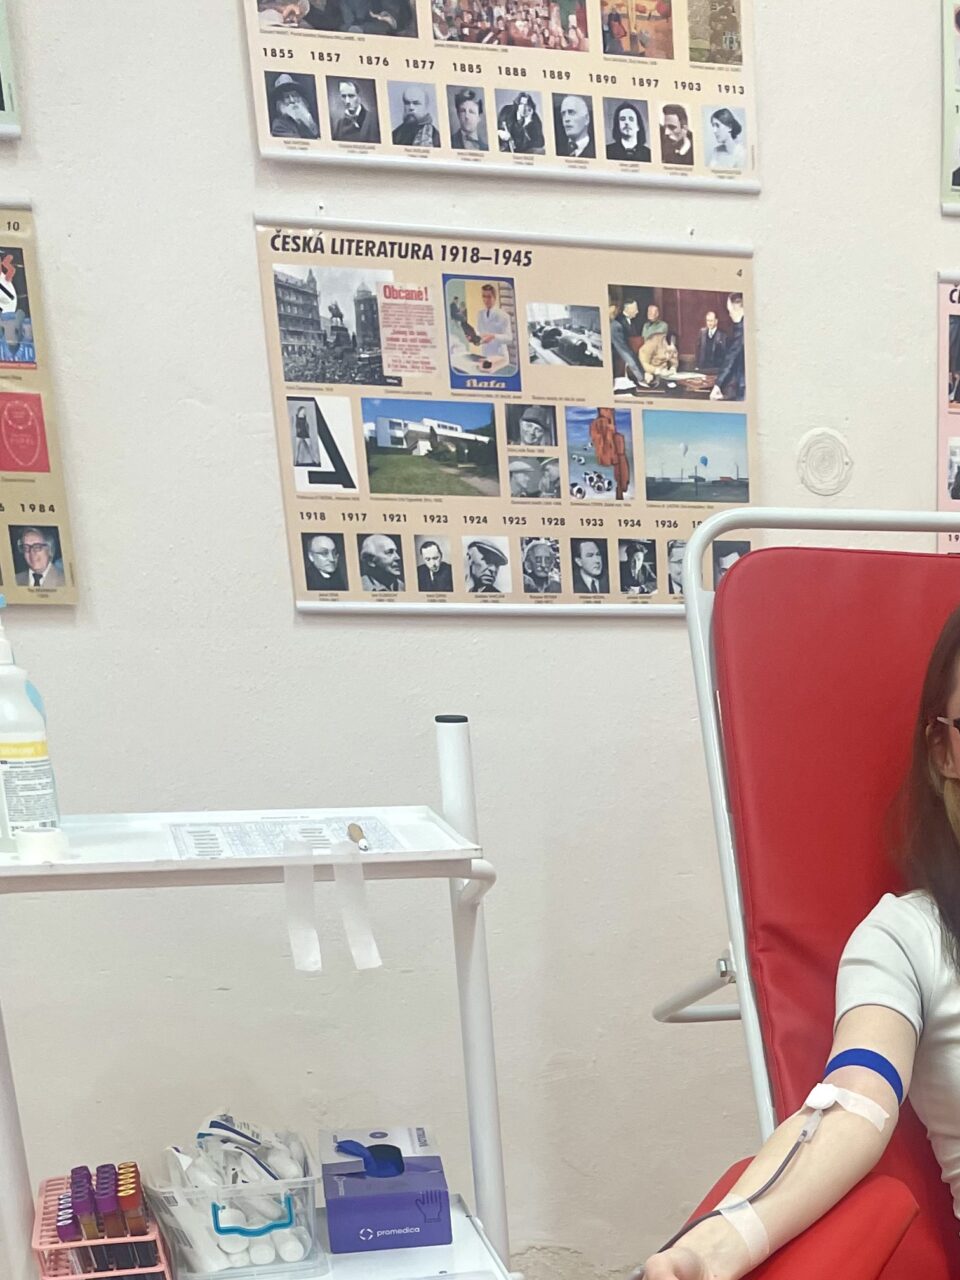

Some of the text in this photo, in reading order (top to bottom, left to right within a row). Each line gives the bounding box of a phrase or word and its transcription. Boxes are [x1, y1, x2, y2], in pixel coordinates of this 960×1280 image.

[263, 47, 745, 95] 1855 1857 1876 1877 1885 1888 1889 1890 1897 1903 1913
[7, 221, 20, 231] 10
[270, 229, 325, 254] ČESKÁ
[330, 238, 434, 261] LITERATURA
[20, 503, 56, 513] 1984
[341, 512, 367, 522] 1917
[382, 513, 407, 523] 1921
[423, 514, 448, 524] 1923
[463, 515, 488, 525] 1924
[502, 516, 527, 526] 1925
[541, 517, 566, 527] 1928
[579, 518, 604, 528] 1933
[618, 518, 642, 528] 1934
[655, 519, 679, 529] 1936
[376, 1226, 420, 1237] promedica
